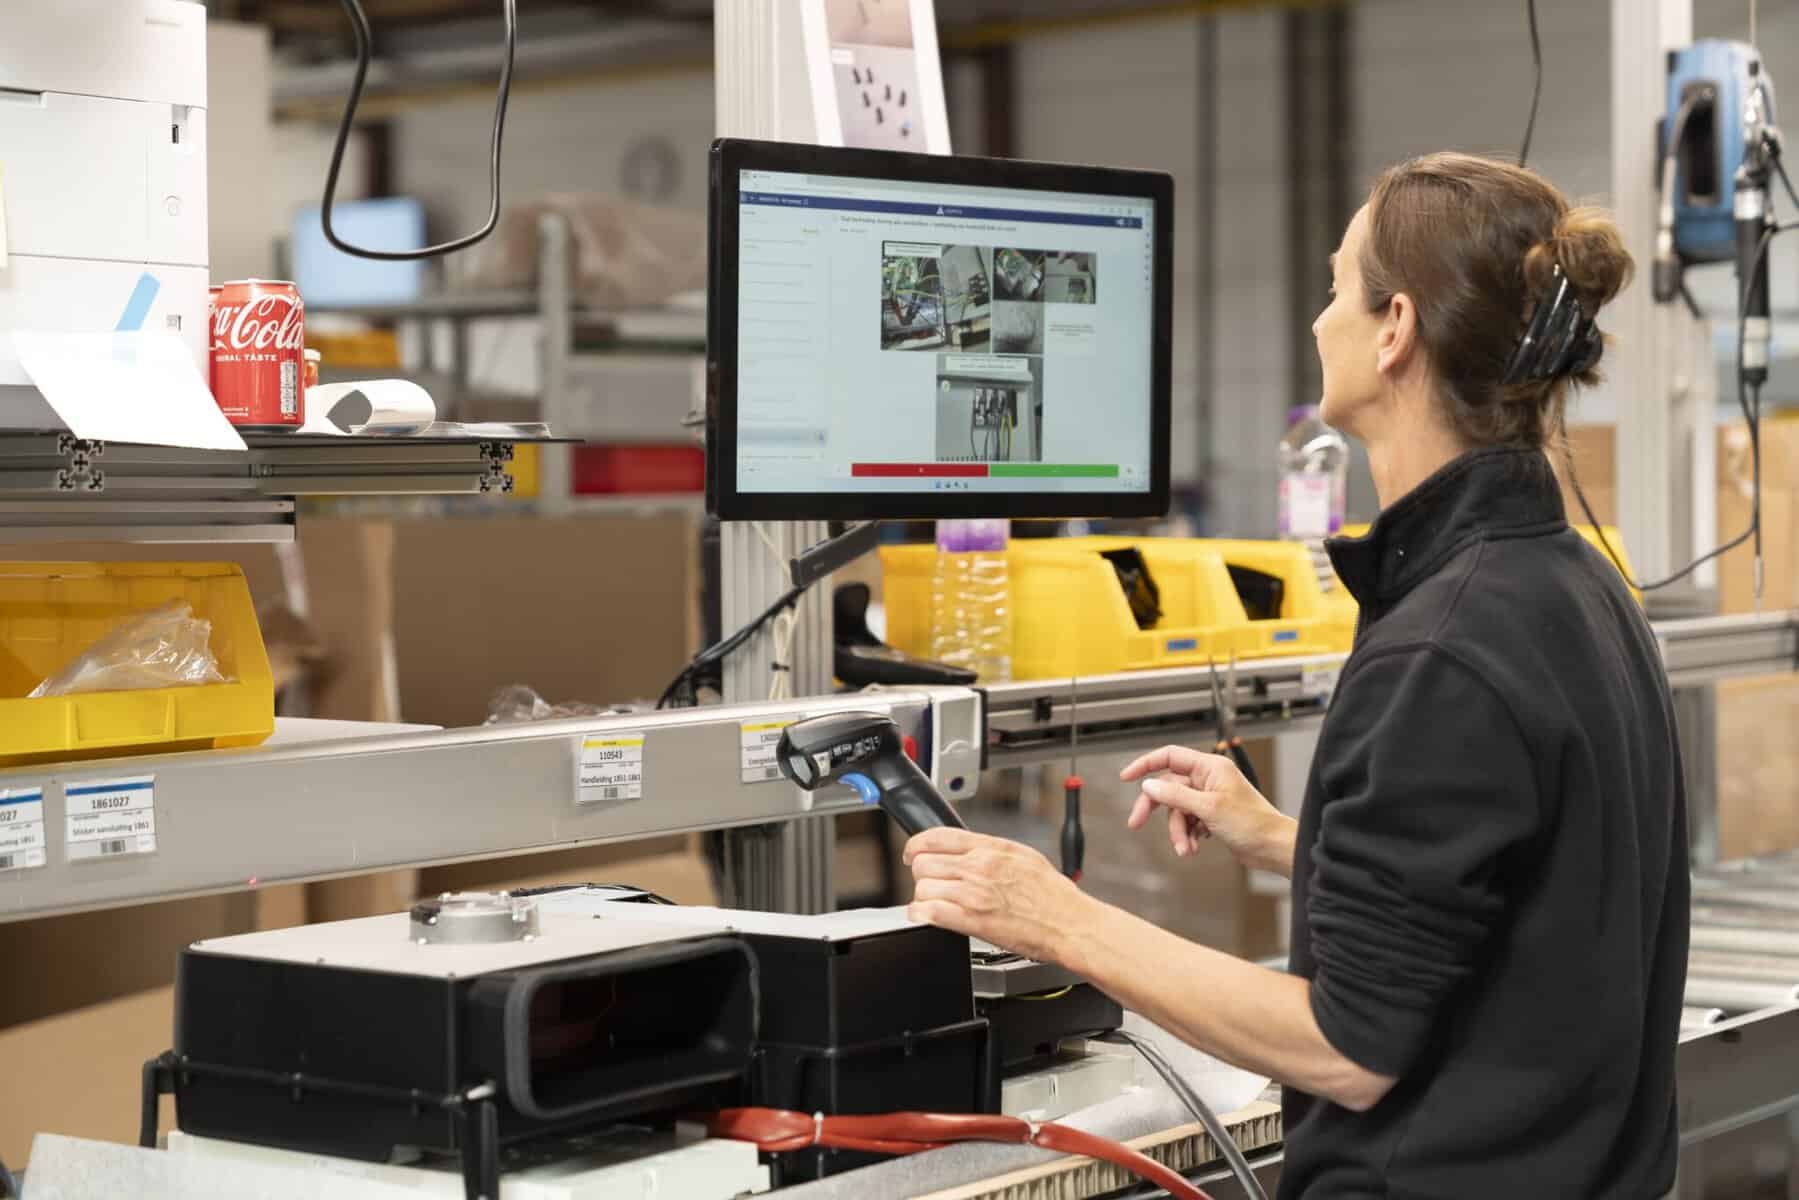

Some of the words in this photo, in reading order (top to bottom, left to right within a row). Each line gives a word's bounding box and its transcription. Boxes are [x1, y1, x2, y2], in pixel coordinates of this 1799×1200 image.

[244, 353, 277, 361] TASTE
[600, 750, 622, 760] 110543
[92, 796, 129, 809] 1861027
